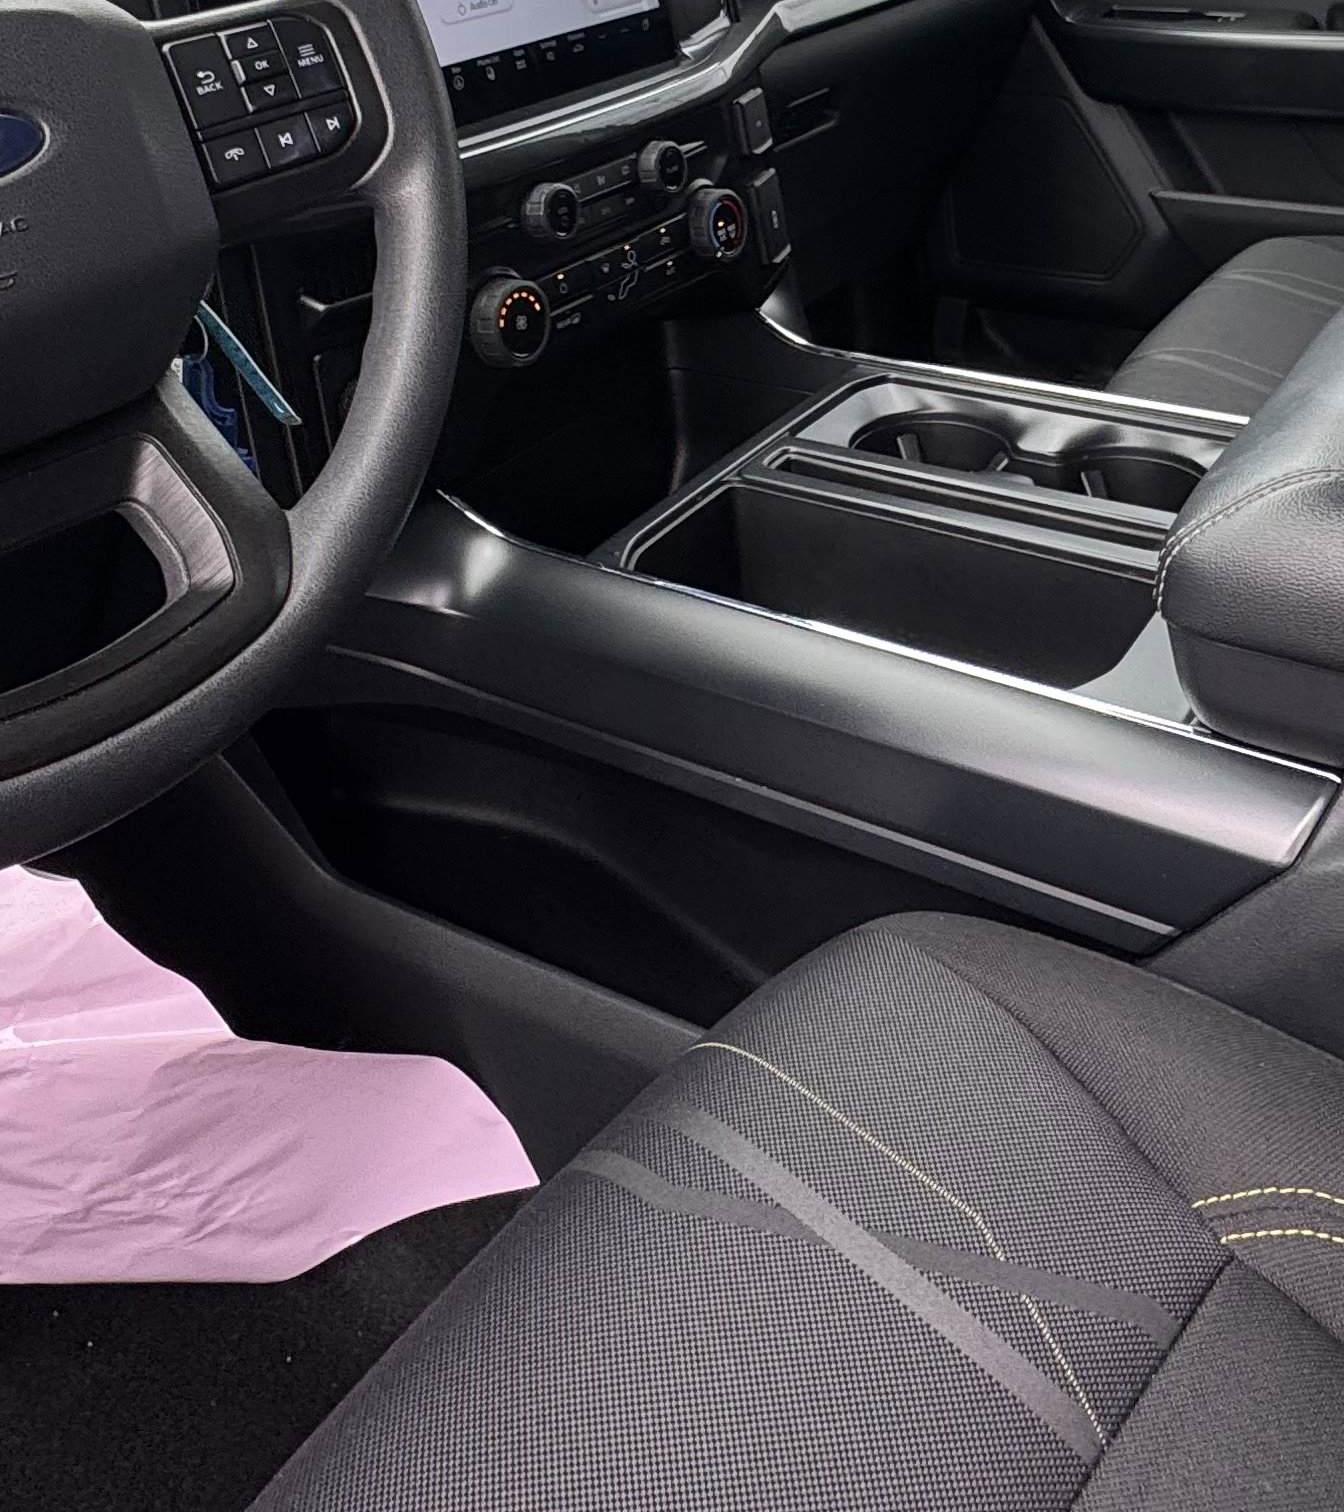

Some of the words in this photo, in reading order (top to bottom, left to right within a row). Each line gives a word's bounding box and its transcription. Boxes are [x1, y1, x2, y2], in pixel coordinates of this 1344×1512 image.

[254, 59, 270, 71] OK
[297, 54, 324, 68] MENU
[196, 80, 224, 96] BACK
